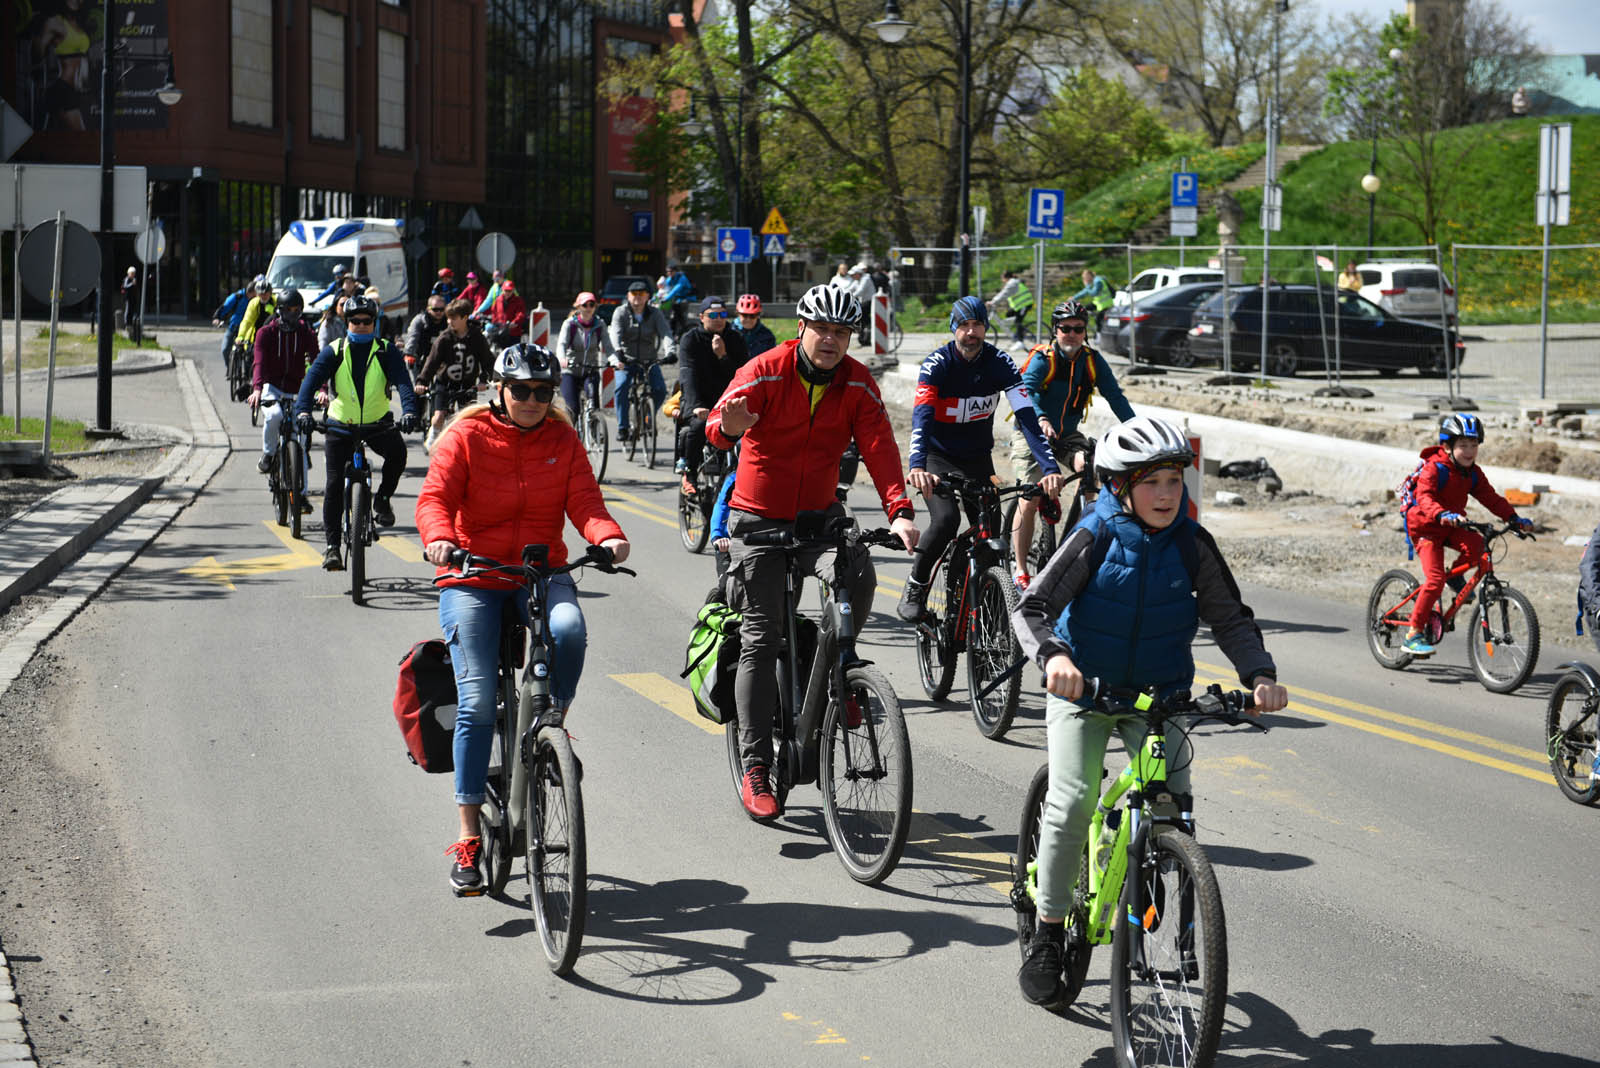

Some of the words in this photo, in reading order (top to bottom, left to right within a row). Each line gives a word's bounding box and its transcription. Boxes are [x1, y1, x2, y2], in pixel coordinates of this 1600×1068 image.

[1178, 176, 1193, 197] P
[1037, 193, 1057, 224] P
[639, 218, 648, 232] P
[920, 352, 945, 376] IAM
[969, 399, 993, 411] IAM
